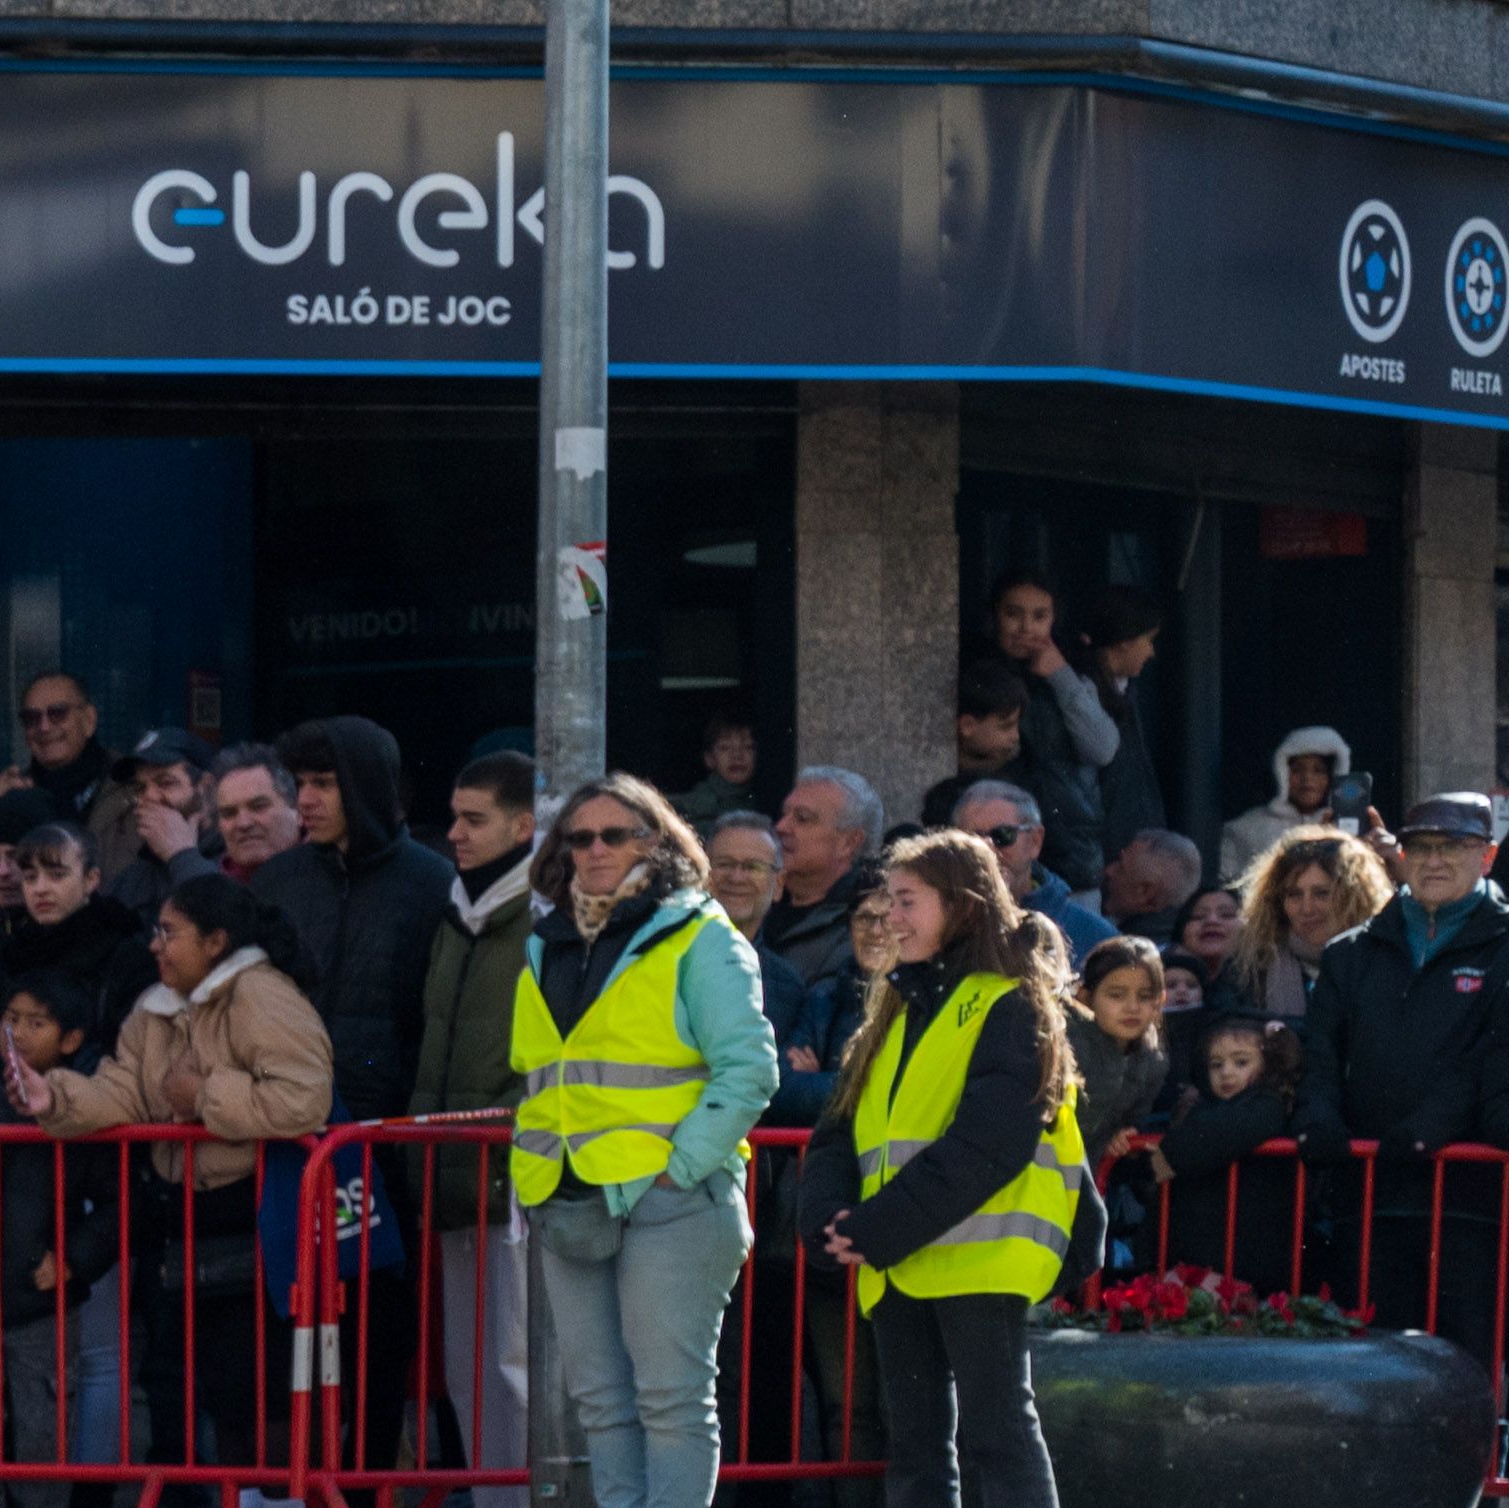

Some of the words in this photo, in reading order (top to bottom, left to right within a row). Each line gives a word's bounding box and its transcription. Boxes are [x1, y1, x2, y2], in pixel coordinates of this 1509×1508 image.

[286, 286, 379, 326] SALÓ
[387, 295, 430, 326] DE
[438, 295, 512, 327] JOC
[1339, 352, 1406, 384] APOSTES
[1450, 367, 1502, 397] RULETA
